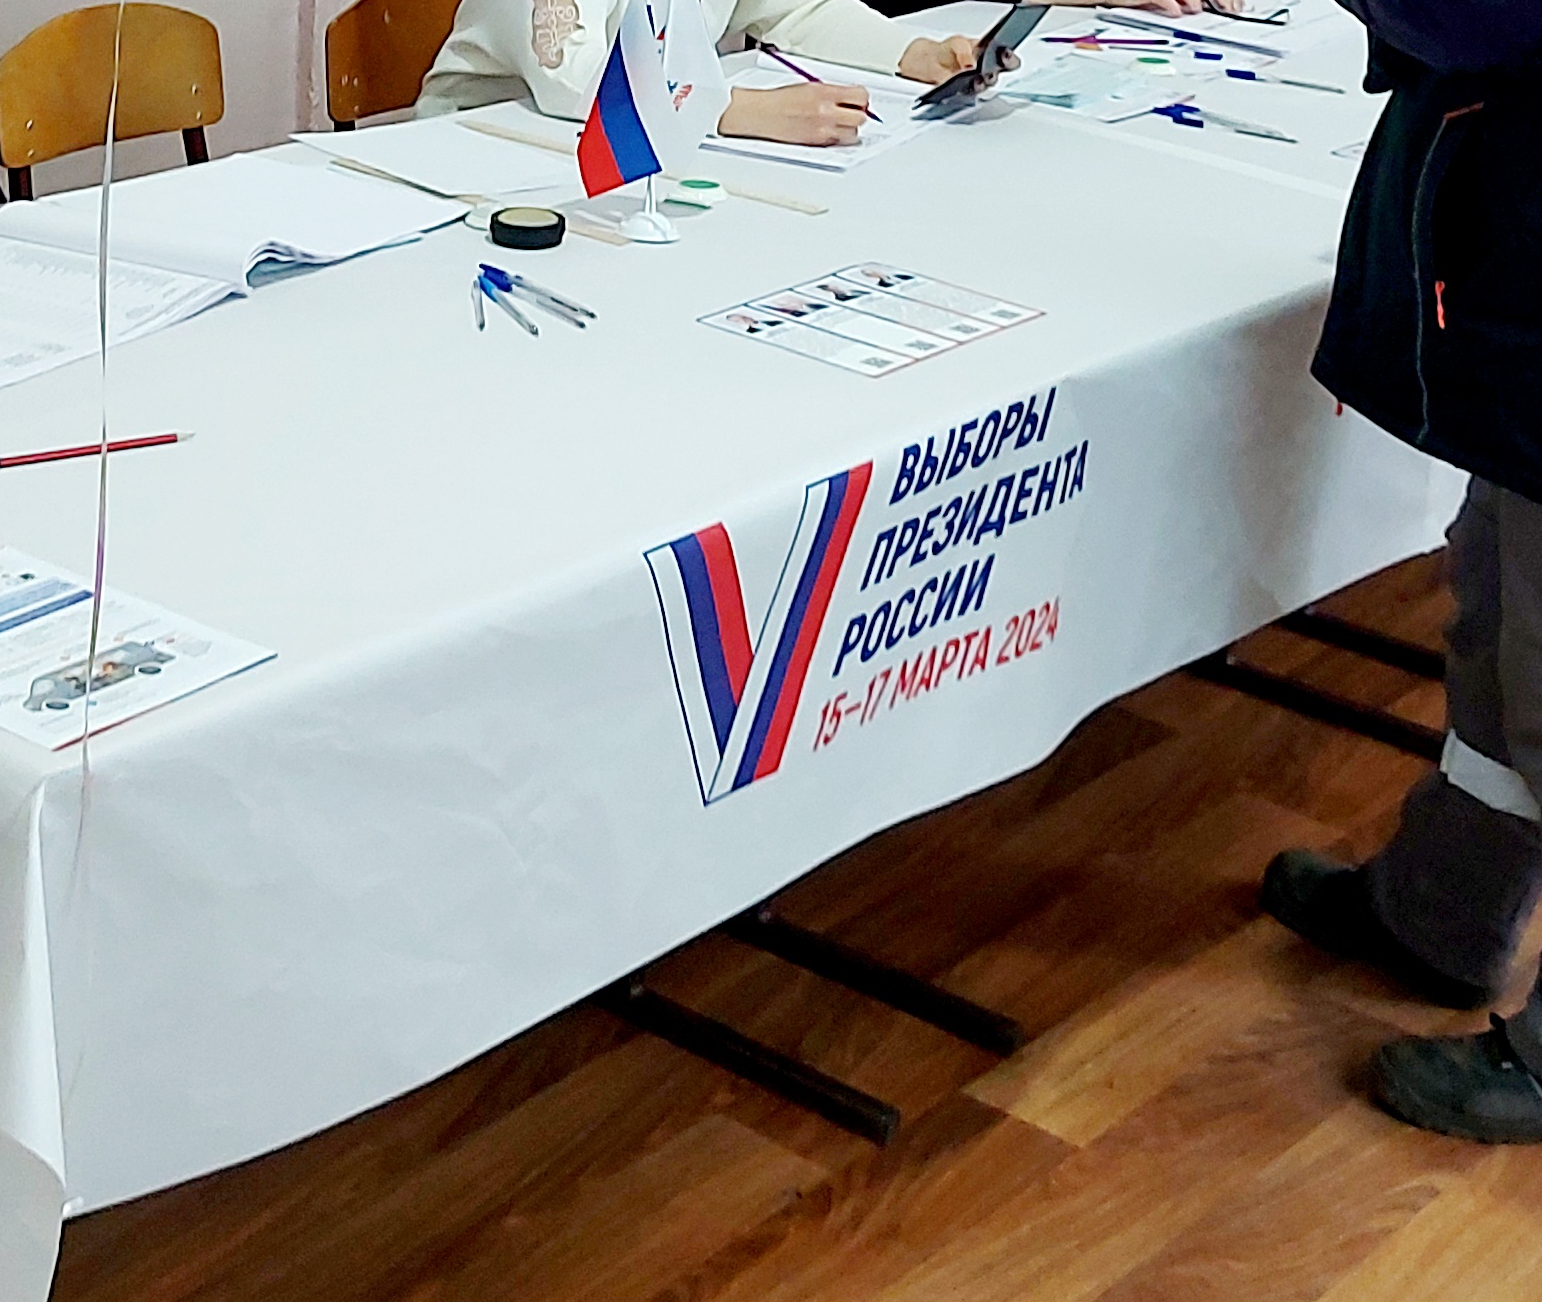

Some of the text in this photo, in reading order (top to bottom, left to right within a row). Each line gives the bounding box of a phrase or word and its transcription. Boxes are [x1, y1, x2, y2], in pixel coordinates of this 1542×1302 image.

[889, 386, 1057, 505] ВЫБОРЫ
[860, 440, 1089, 593] ПРЕЗИДЕНТА
[832, 554, 996, 678] РОССИИ
[889, 624, 992, 710] МАРТА
[996, 595, 1060, 666] 2024
